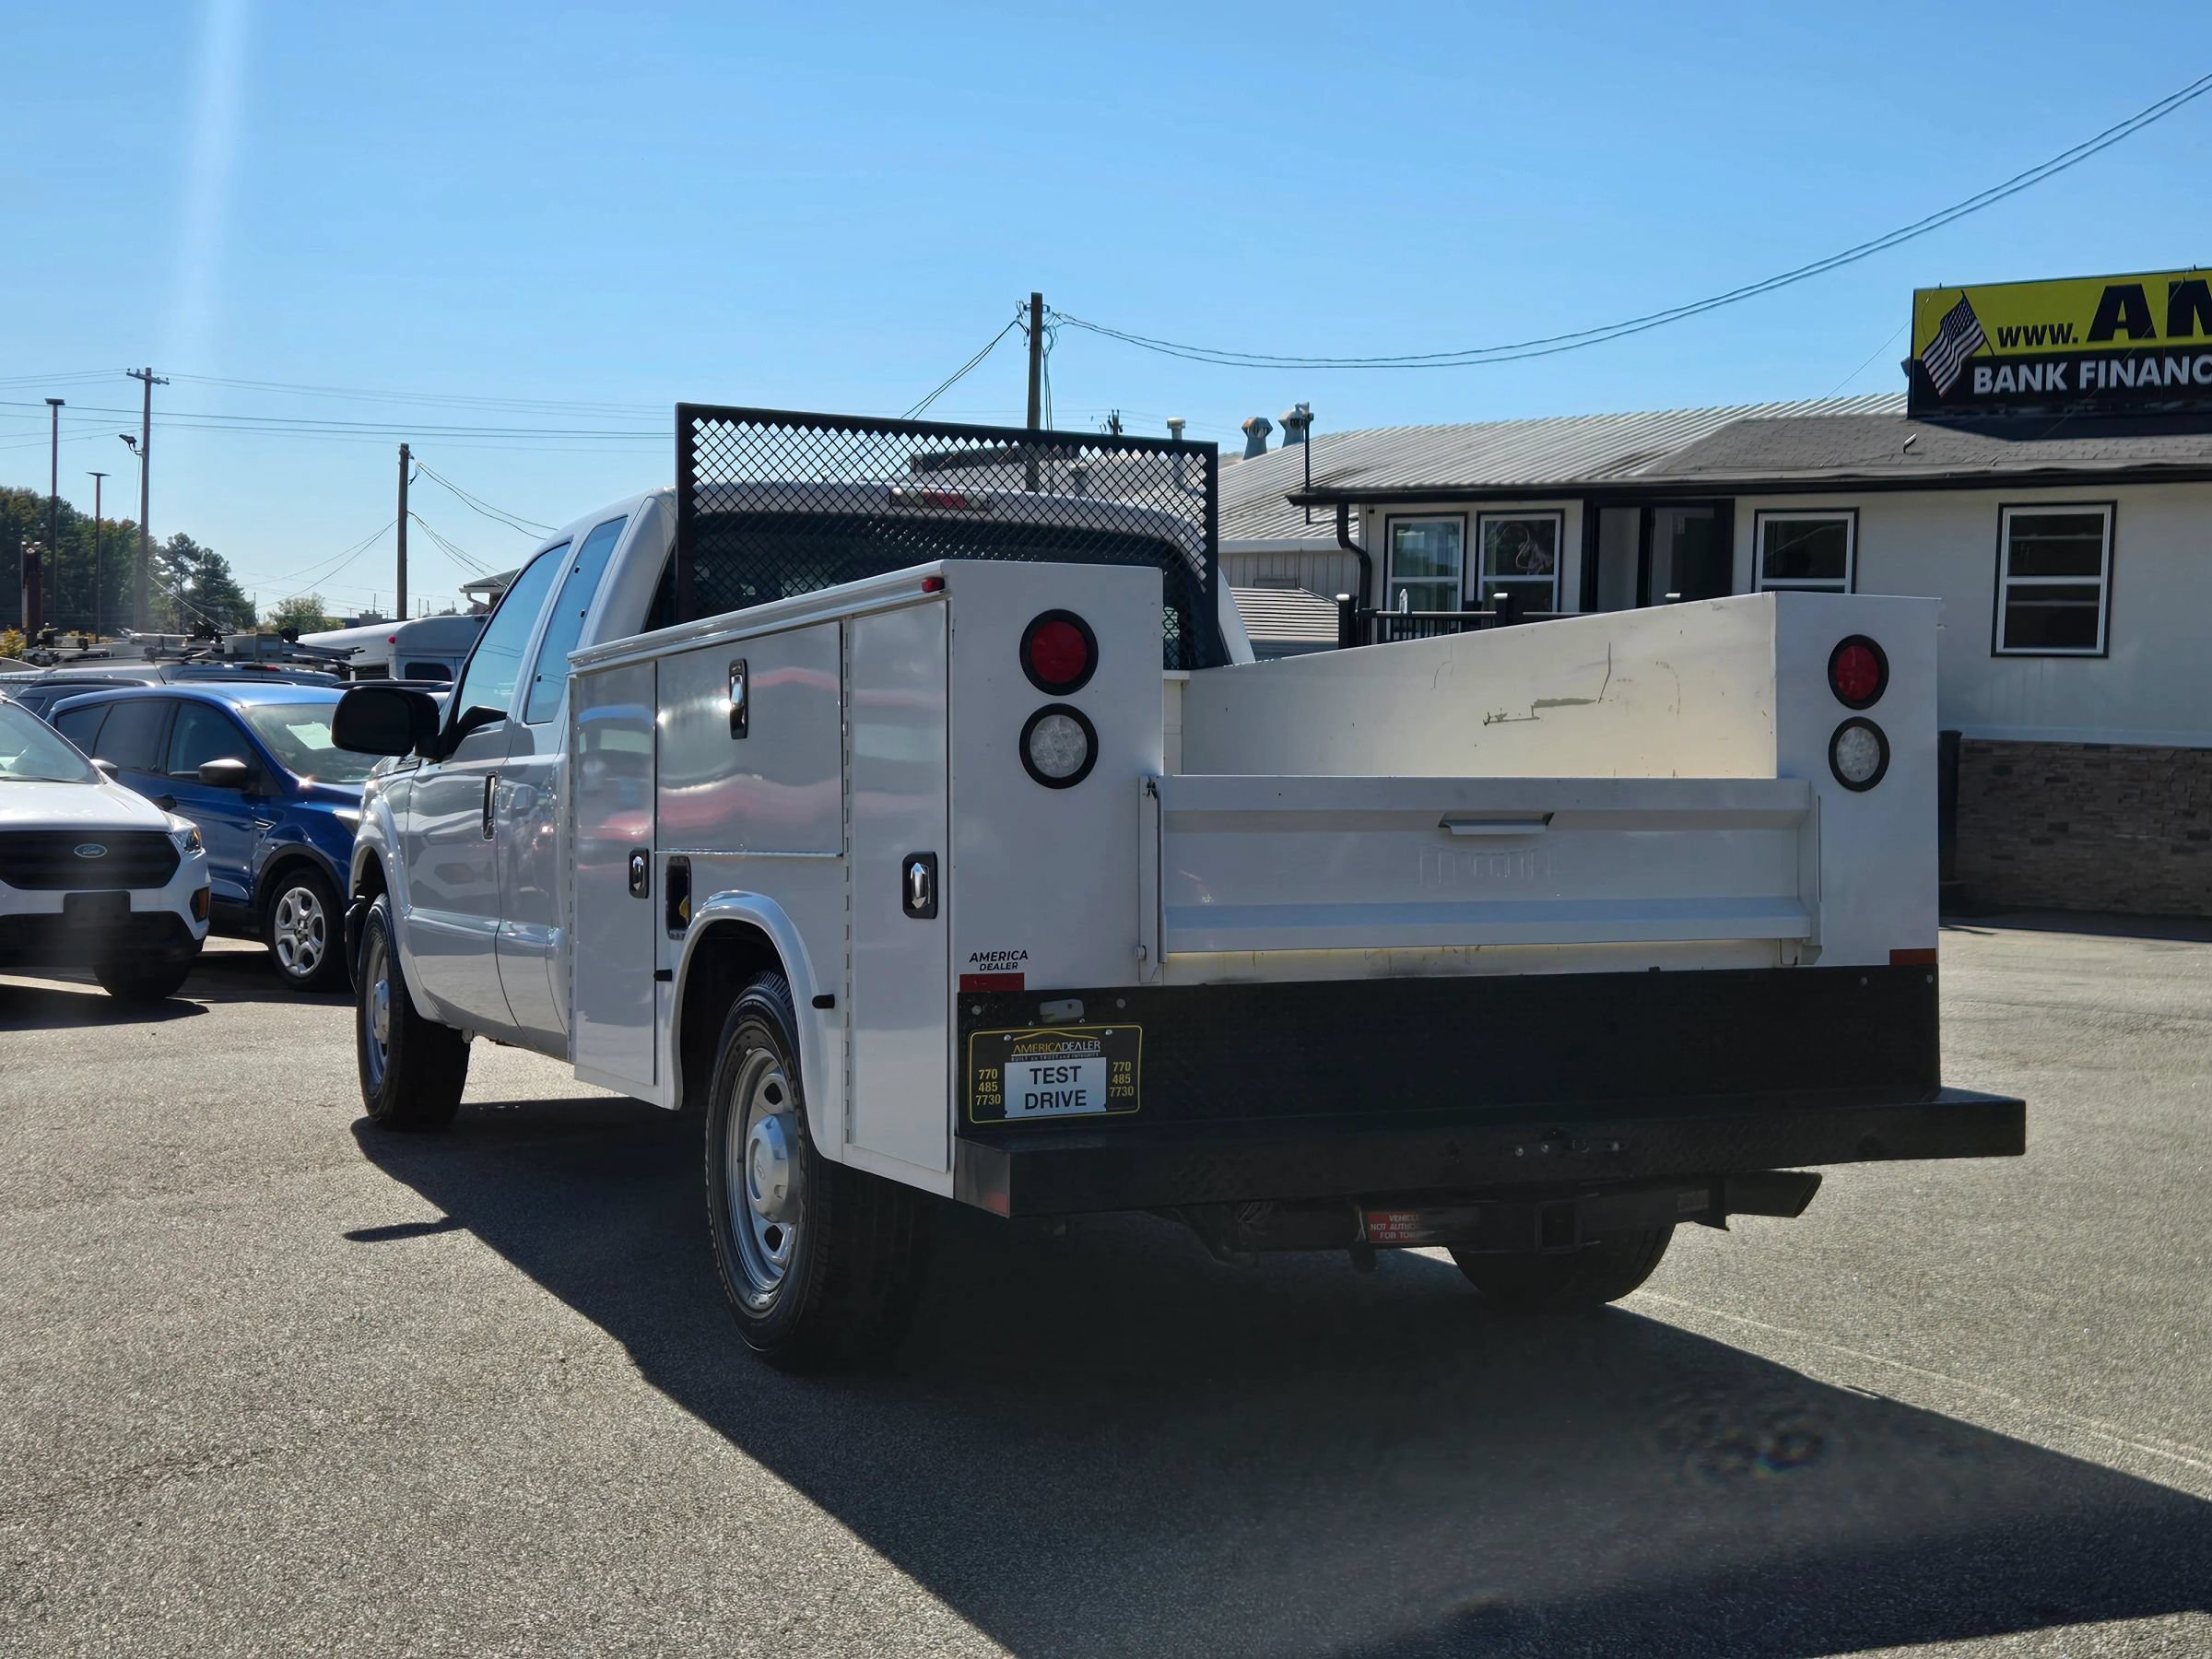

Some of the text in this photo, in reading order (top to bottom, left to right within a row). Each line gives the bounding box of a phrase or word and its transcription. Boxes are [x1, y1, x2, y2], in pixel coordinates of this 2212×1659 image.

[1973, 354, 2212, 395] BANK FINANC
[969, 949, 1029, 963] AMERICA
[979, 961, 1018, 971] DEALER
[1112, 1062, 1132, 1073] 770
[978, 1068, 998, 1080] 770
[1029, 1065, 1082, 1085] TEST
[1112, 1074, 1131, 1085] 485
[978, 1081, 998, 1093] 485
[1109, 1086, 1135, 1098] 7730
[975, 1094, 1001, 1106] 7730
[1024, 1089, 1088, 1110] DRIVE
